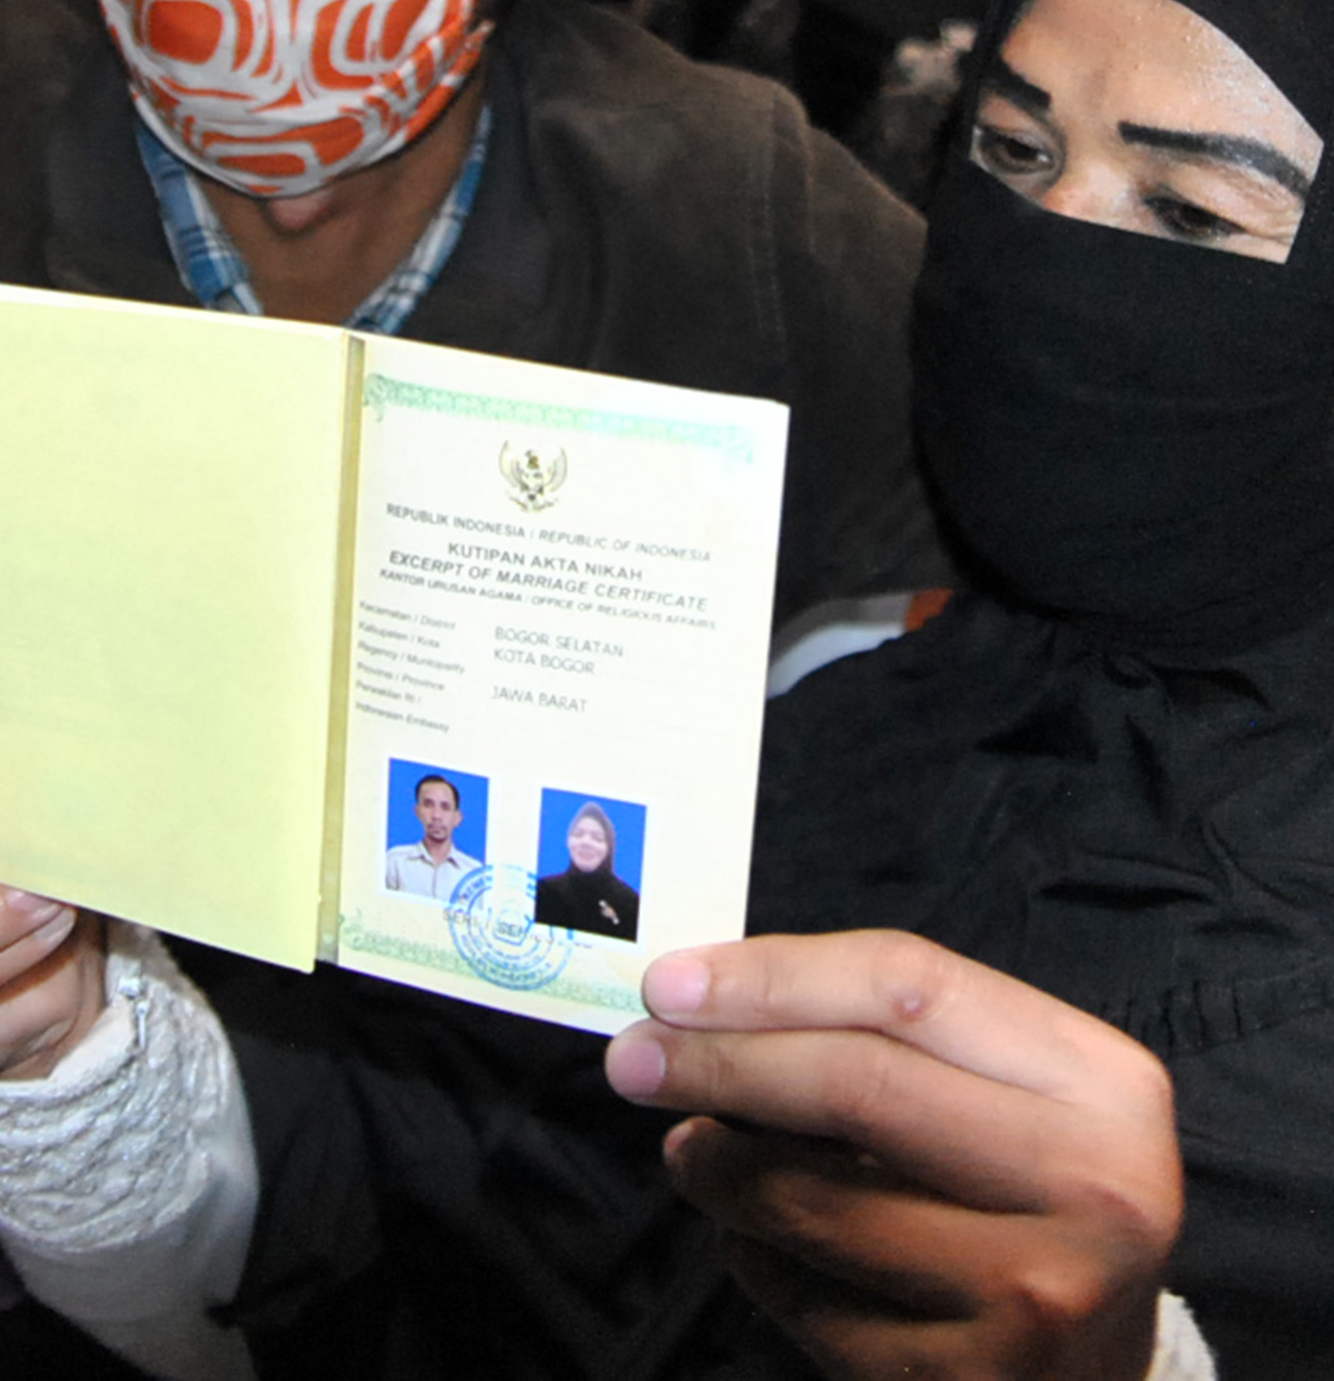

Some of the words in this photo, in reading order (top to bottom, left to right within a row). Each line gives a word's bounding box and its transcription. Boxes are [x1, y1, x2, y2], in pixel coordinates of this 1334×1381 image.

[386, 502, 448, 526] REPUBLIK
[453, 516, 525, 538] INDONESIA
[539, 529, 608, 549] REPUBLIC
[613, 539, 631, 551] OF
[635, 542, 710, 561] INDONESIA
[389, 550, 464, 576] EXCERPT
[468, 566, 492, 580] OF
[496, 570, 588, 595] MARRIAGE
[594, 583, 708, 612] CERTIFICATE
[448, 542, 525, 566] KUTIPAN
[530, 555, 578, 573] AKTA
[585, 562, 643, 581] NIKAH
[379, 569, 425, 586] KANTOR
[428, 579, 476, 595] URUSAN
[479, 588, 522, 601] AGAMA
[531, 596, 574, 610] OFFICE
[578, 602, 593, 612] OF
[494, 626, 549, 646] BOGOR
[556, 636, 623, 657] SELATAN
[494, 648, 535, 665] KOTA
[540, 653, 595, 675] BOGOR
[491, 686, 533, 703] JAWA
[538, 692, 587, 712] BARAT
